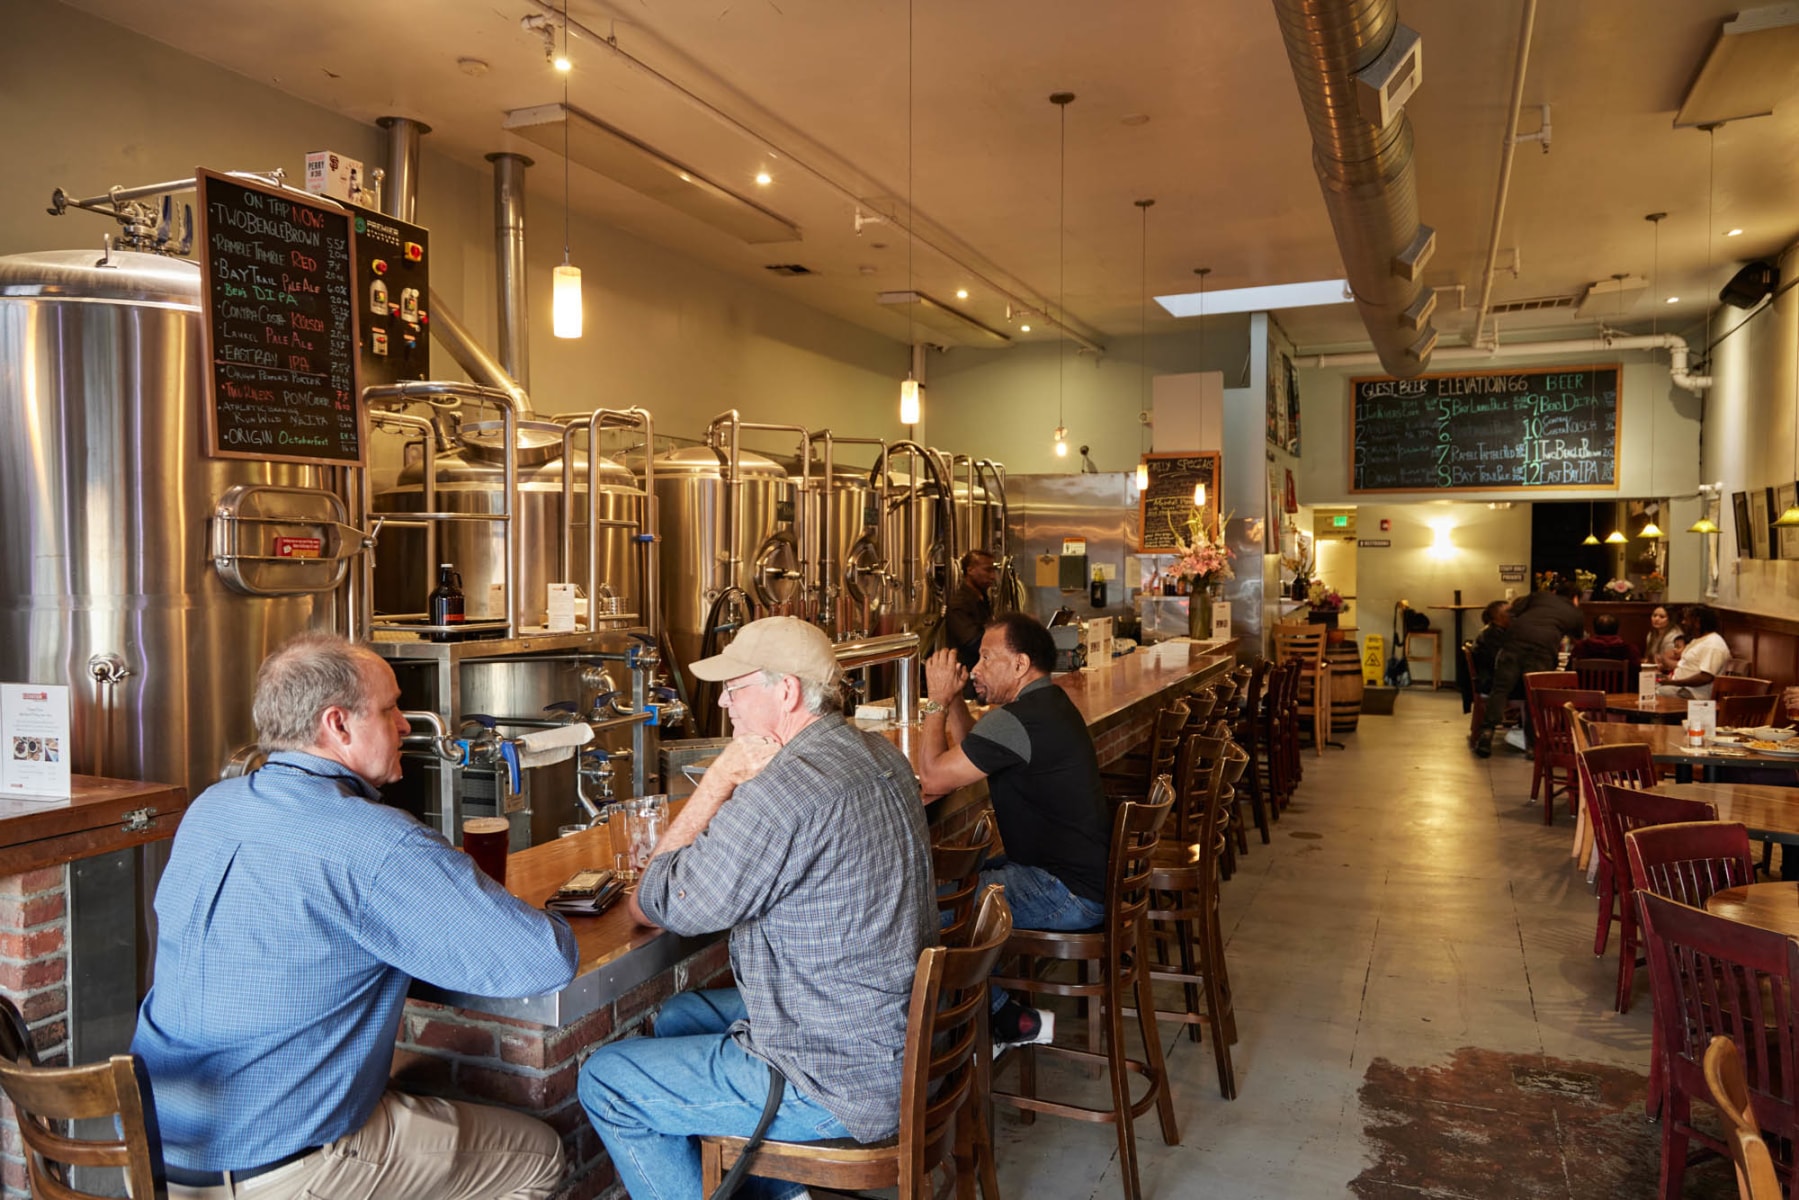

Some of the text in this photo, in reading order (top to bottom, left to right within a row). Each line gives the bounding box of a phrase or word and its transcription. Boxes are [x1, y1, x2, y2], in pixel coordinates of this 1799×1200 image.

[244, 192, 263, 209] ON
[267, 198, 290, 218] TAP
[291, 250, 317, 272] RED
[289, 355, 310, 372] IPA
[1399, 380, 1428, 394] BEER
[1438, 375, 1528, 396] ELEVATION 66
[1546, 374, 1584, 391] BEER
[228, 428, 273, 446] ORIGIN
[1578, 460, 1599, 483] IPA
